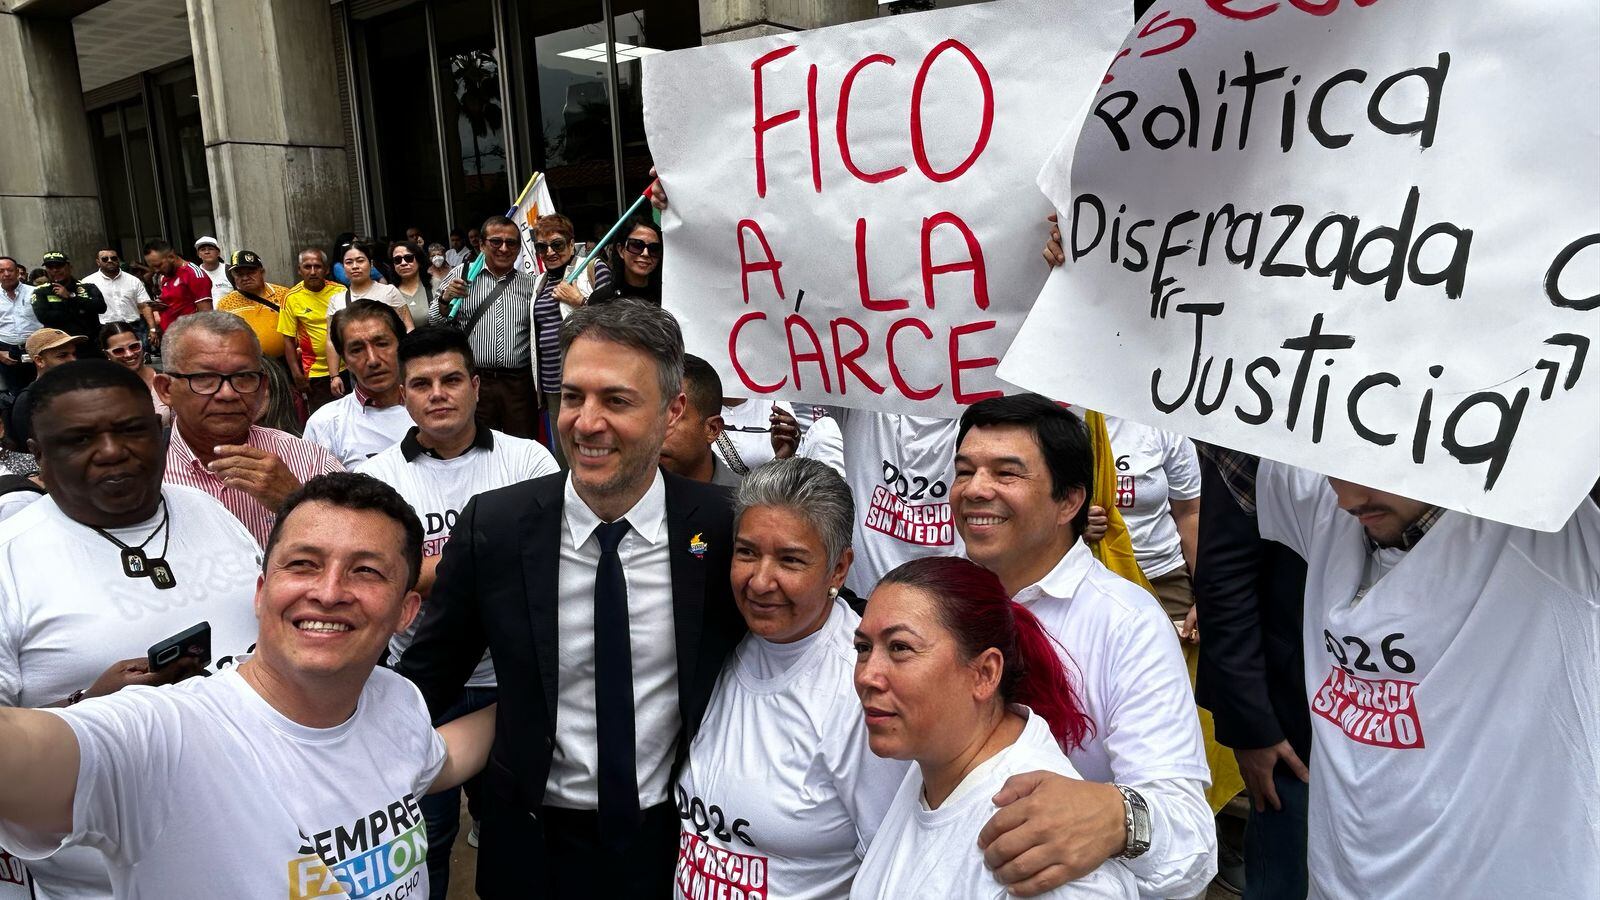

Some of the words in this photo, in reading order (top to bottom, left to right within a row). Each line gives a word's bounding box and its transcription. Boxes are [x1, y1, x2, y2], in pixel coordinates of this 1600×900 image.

[751, 38, 995, 199] FICO
[737, 218, 785, 304] A
[855, 211, 990, 313] LA
[728, 288, 1004, 405] CÁRCE
[1323, 628, 1416, 675] Q26
[298, 792, 420, 867] SEMPRE
